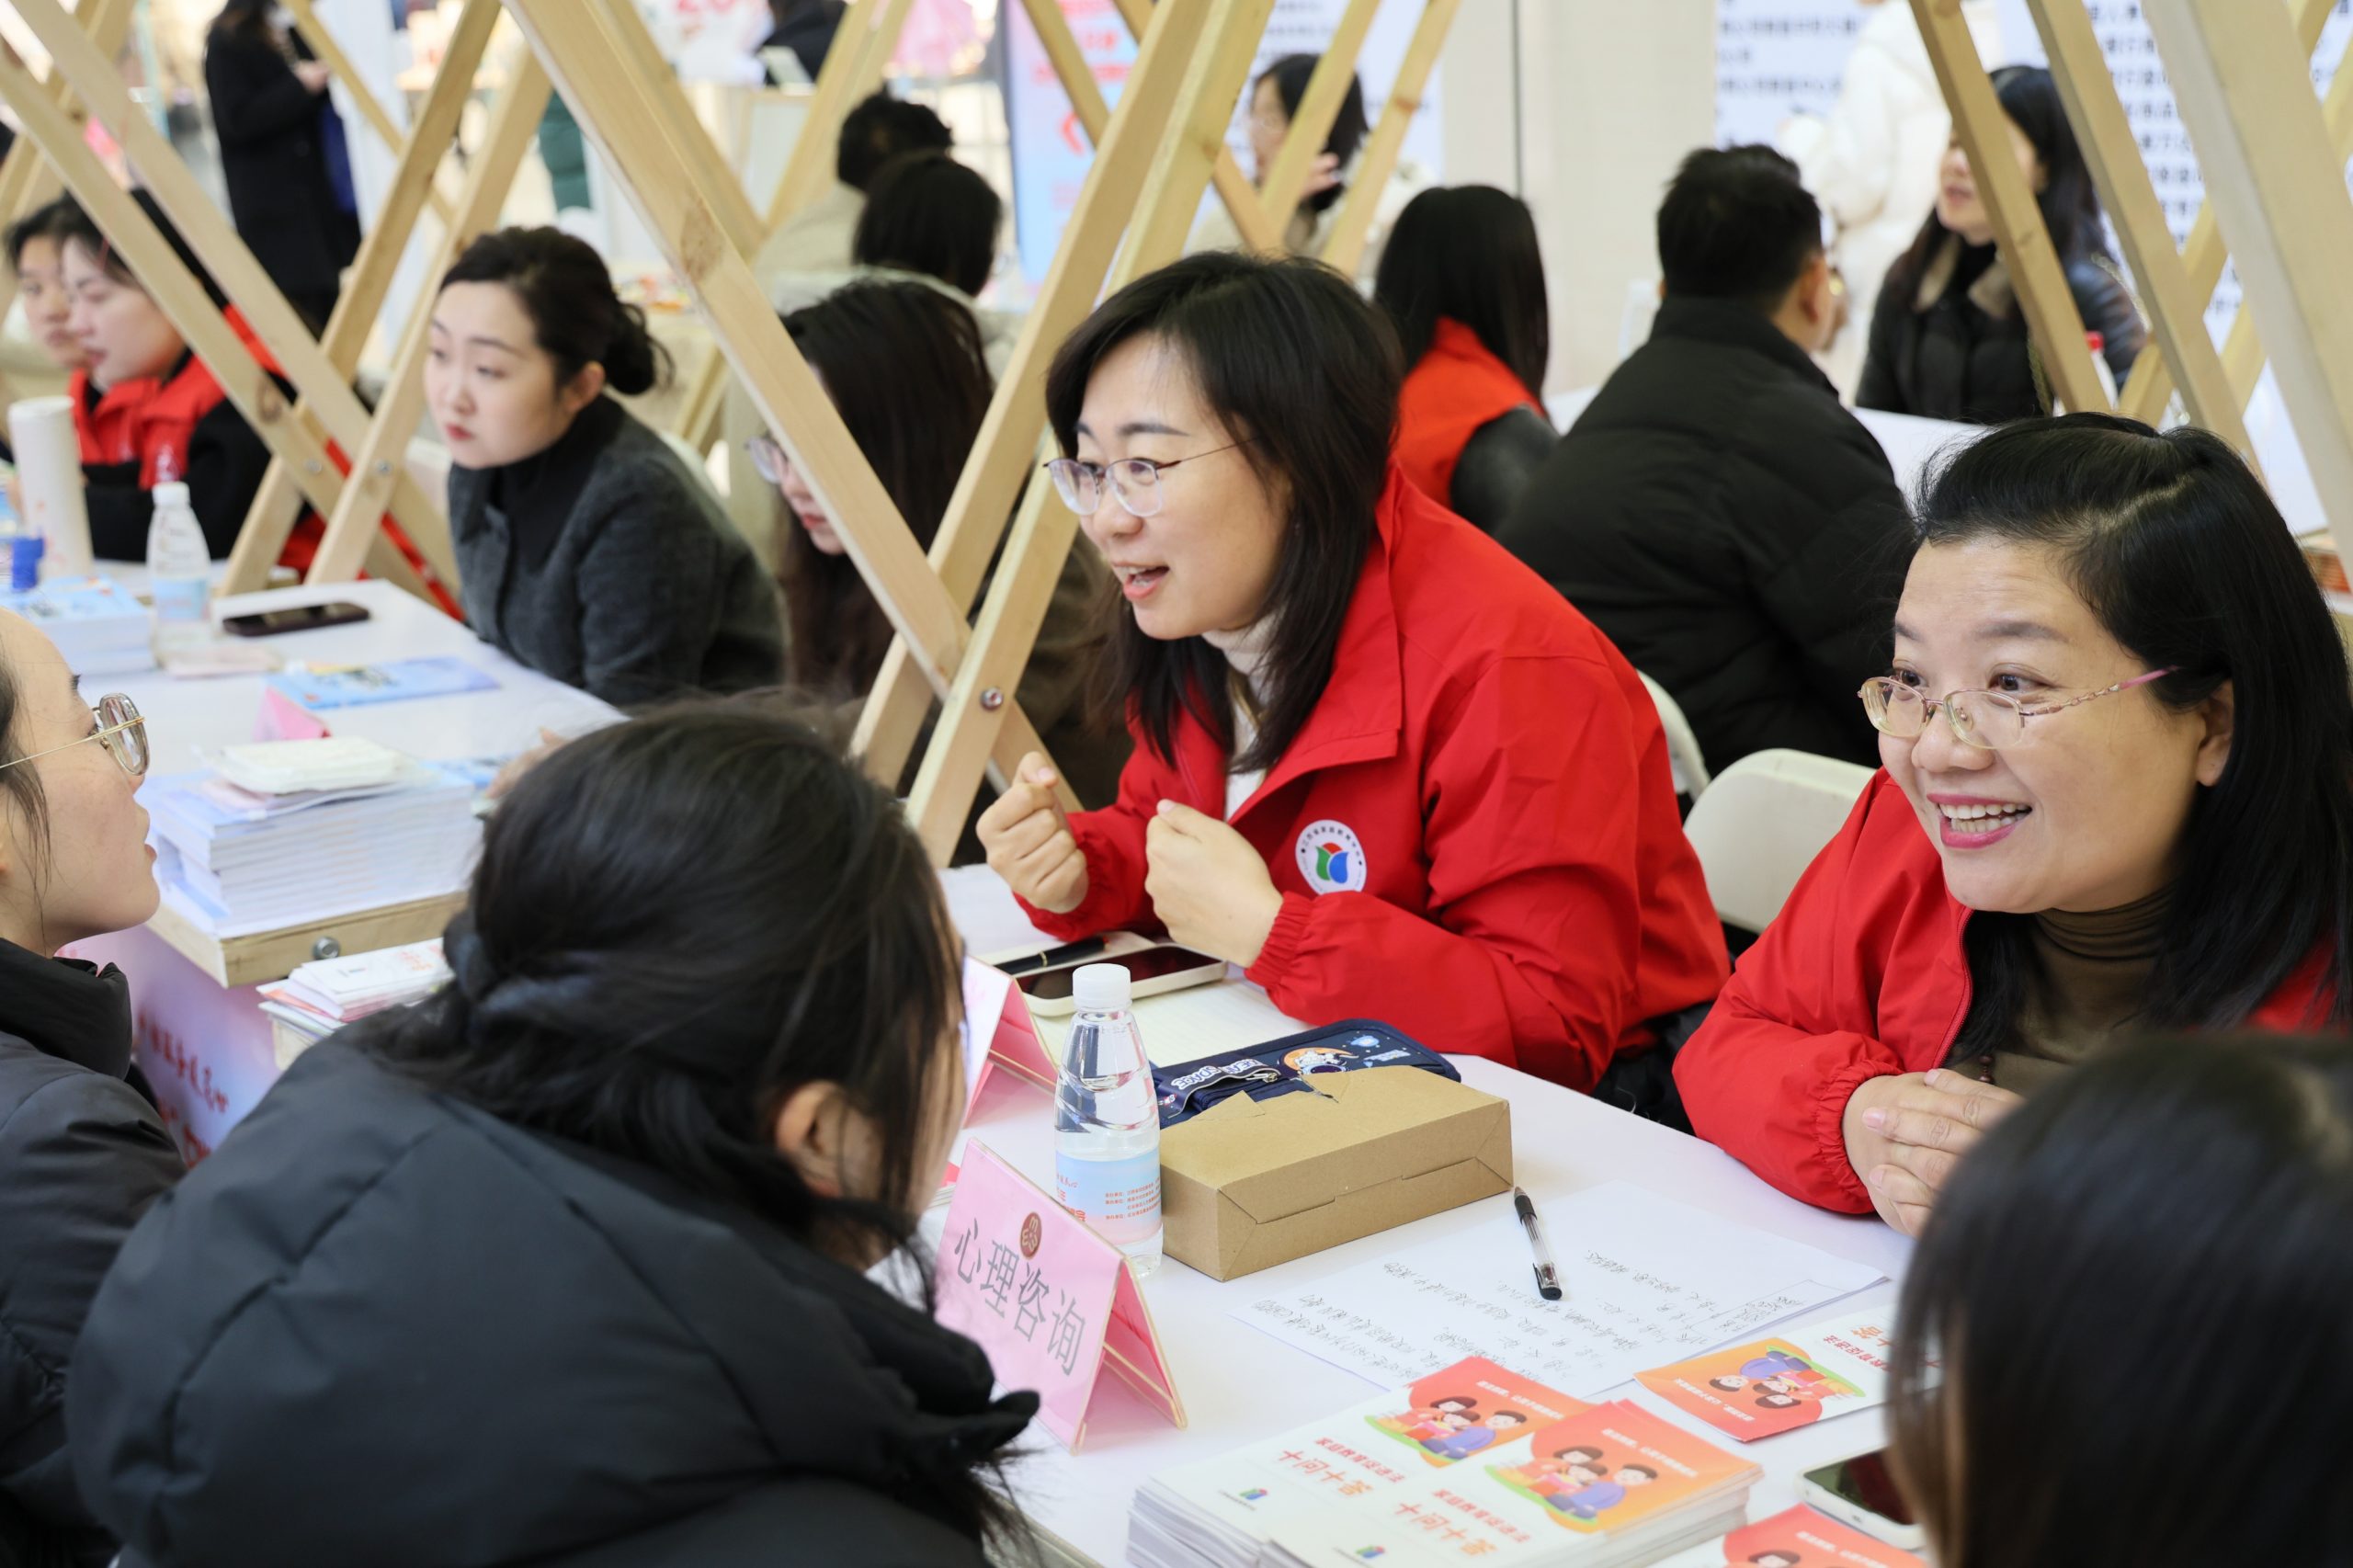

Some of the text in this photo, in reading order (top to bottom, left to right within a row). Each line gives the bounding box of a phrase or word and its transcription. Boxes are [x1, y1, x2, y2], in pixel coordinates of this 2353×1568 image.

[1171, 1065, 1222, 1090] SPACE
[954, 1218, 1086, 1376] 心理咨询
[1279, 1449, 1374, 1497] 十问十答
[1393, 1502, 1498, 1558] 十问十答
